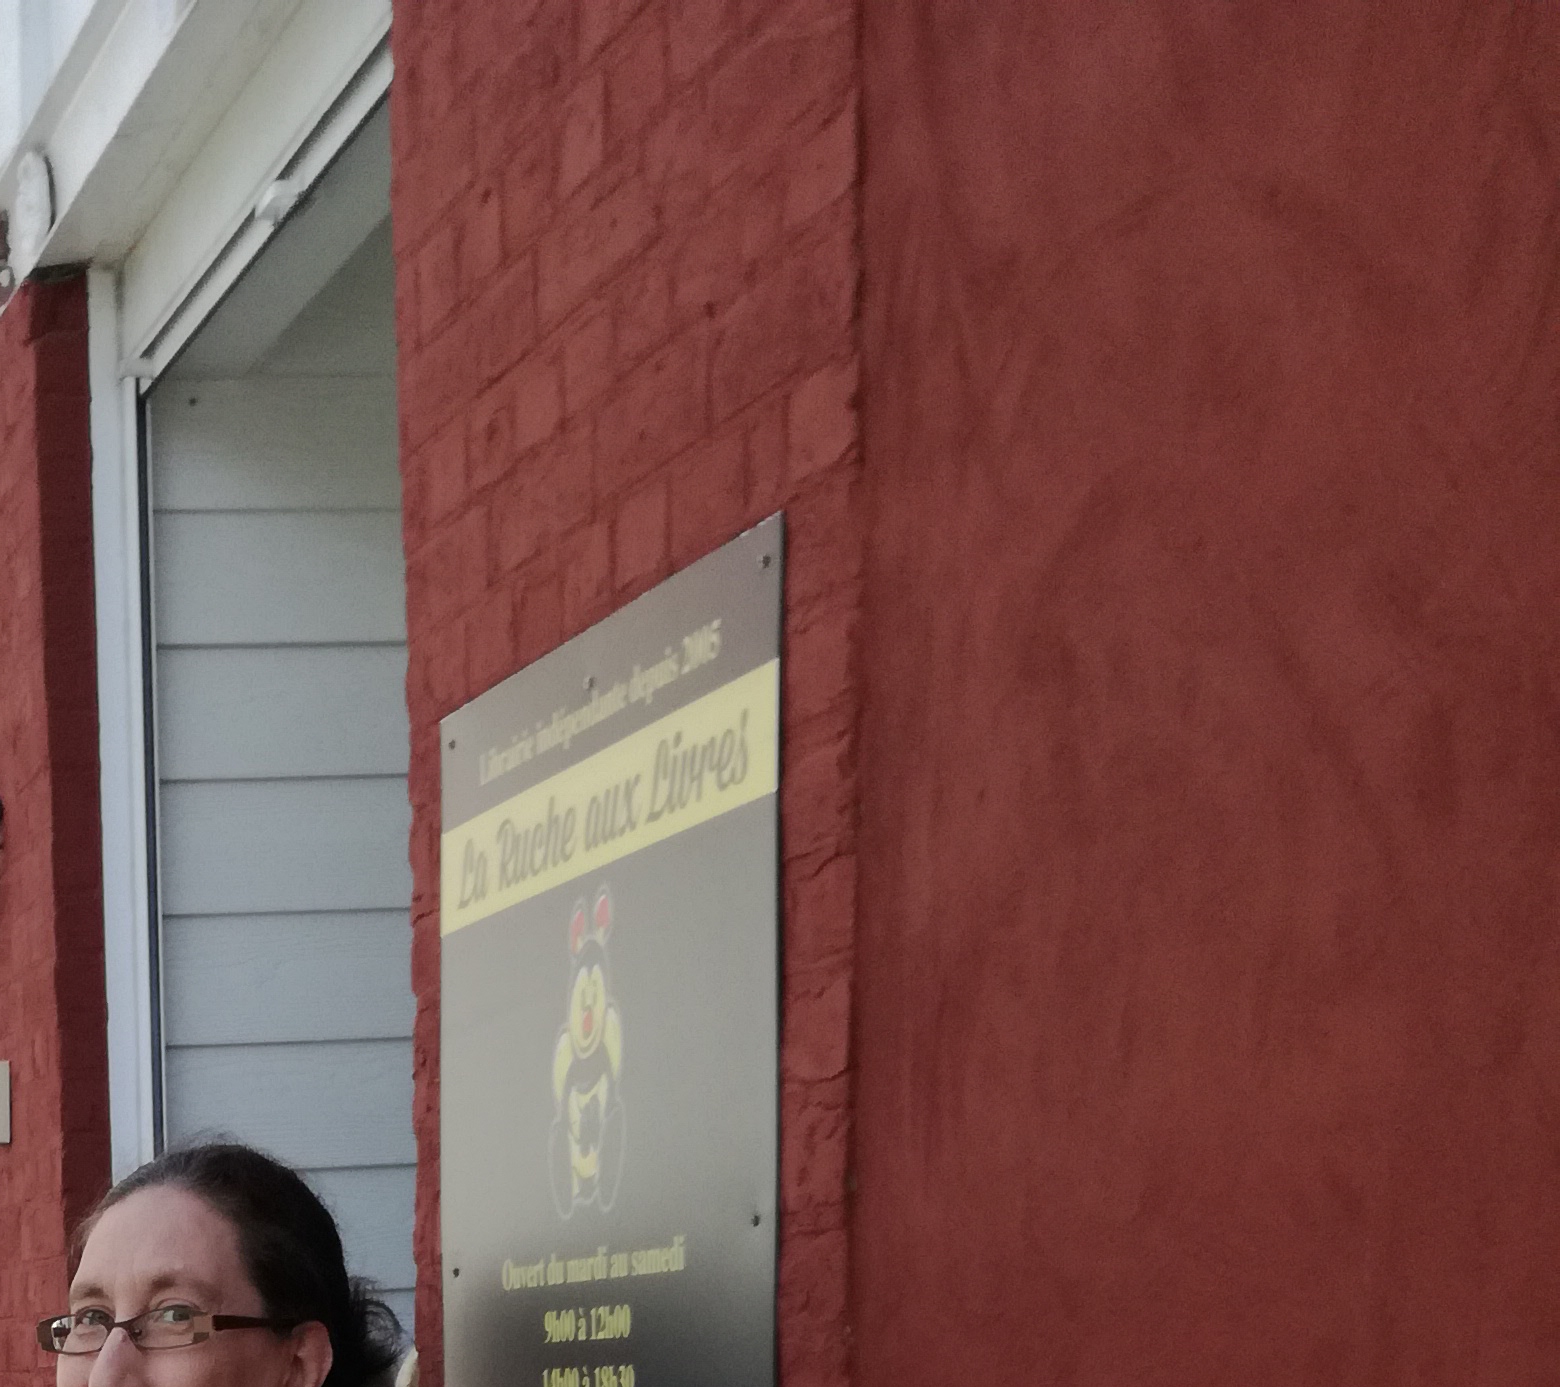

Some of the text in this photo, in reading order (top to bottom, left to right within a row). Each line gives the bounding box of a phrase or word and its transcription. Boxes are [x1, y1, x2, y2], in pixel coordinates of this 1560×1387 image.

[535, 682, 629, 750] indépendante
[627, 645, 680, 705] depuis
[457, 708, 749, 911] La Ruche aux Livres
[501, 1235, 686, 1291] Ouvert du mardi au samedi
[544, 1304, 632, 1344] 9h00 à 12h00
